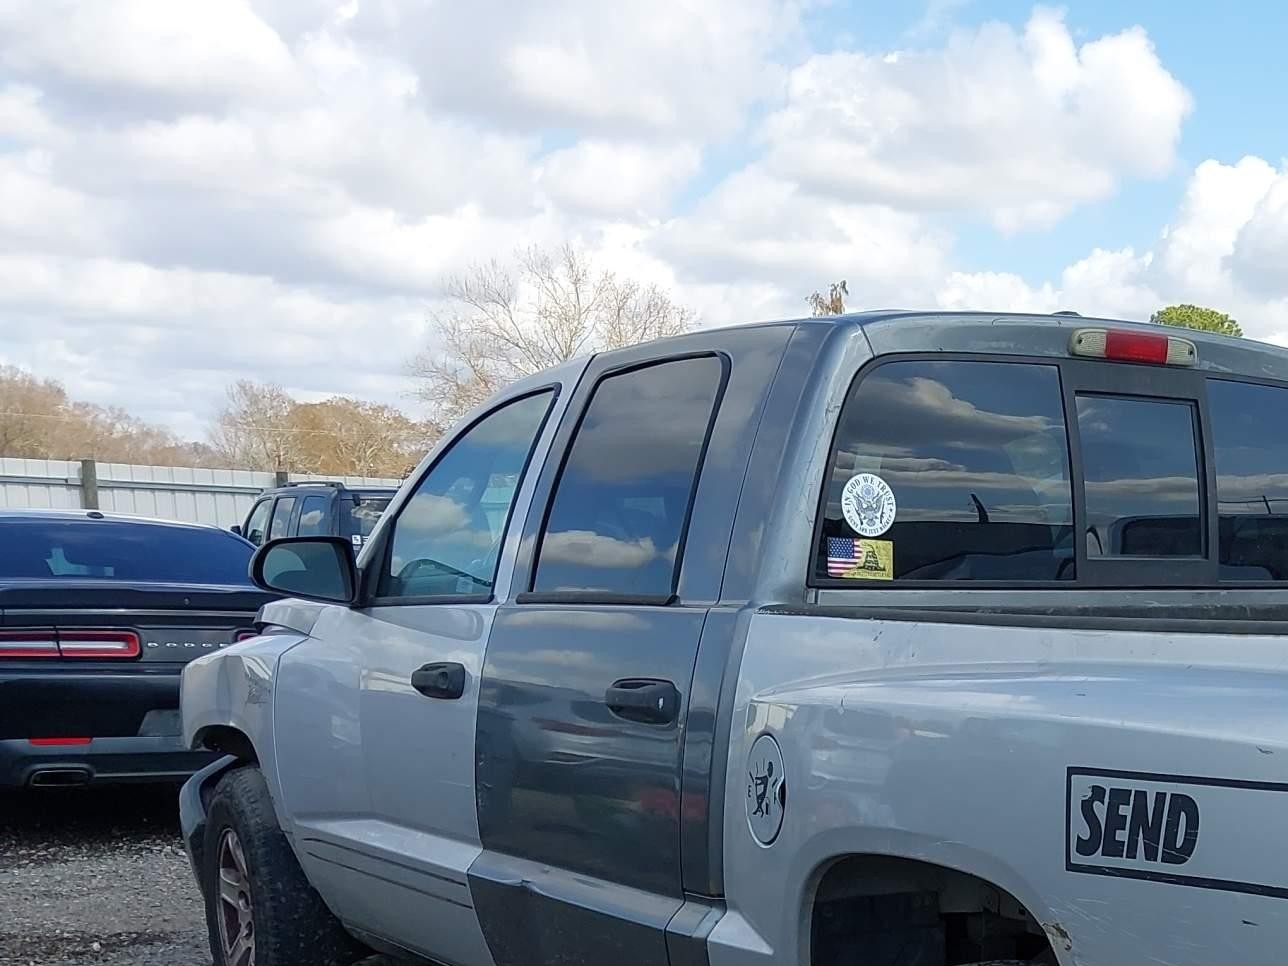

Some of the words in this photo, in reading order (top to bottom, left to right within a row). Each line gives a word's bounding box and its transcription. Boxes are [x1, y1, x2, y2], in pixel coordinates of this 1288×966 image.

[847, 478, 860, 494] GOD
[862, 475, 874, 486] WE
[877, 480, 894, 506] TRUST
[844, 497, 852, 506] IN
[1076, 785, 1200, 865] SEND
